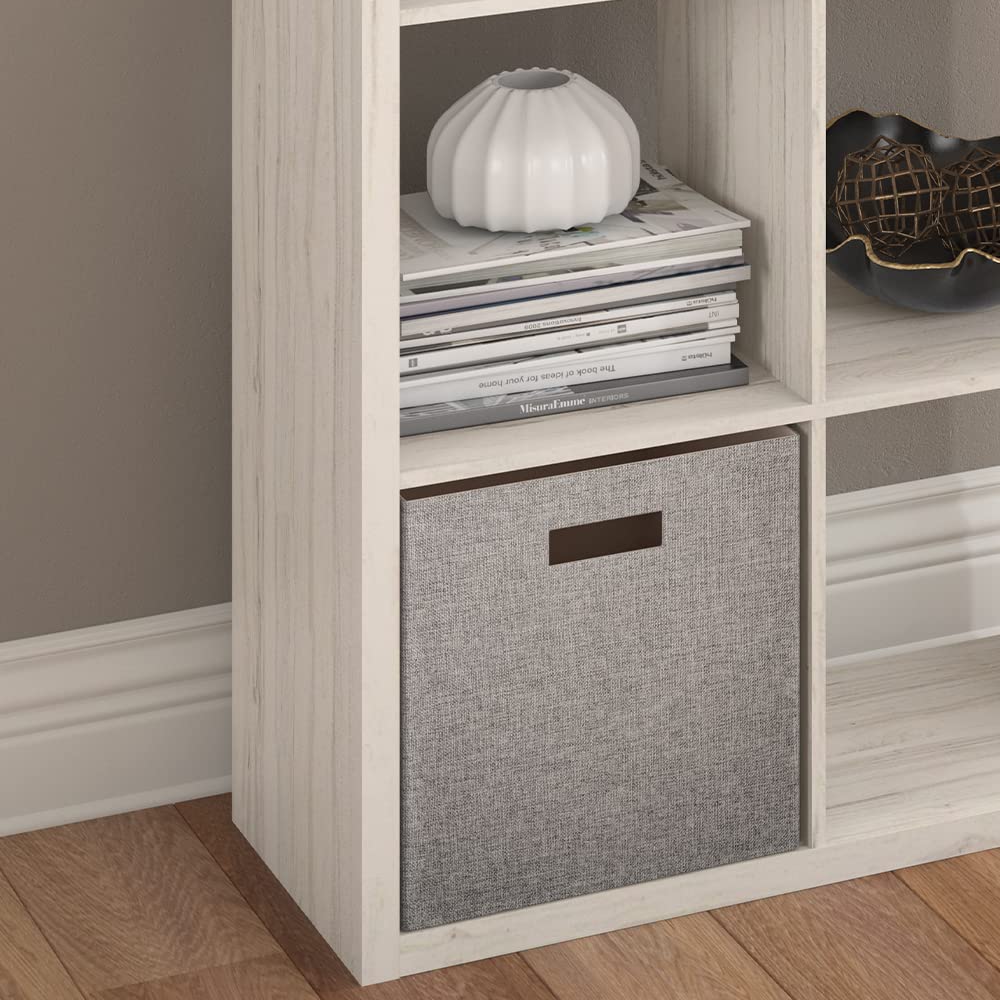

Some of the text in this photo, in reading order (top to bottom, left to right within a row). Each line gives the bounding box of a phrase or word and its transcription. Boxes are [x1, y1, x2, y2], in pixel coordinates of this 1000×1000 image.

[478, 364, 616, 389] The book of ideas for your home
[519, 398, 586, 415] MisuraEmme
